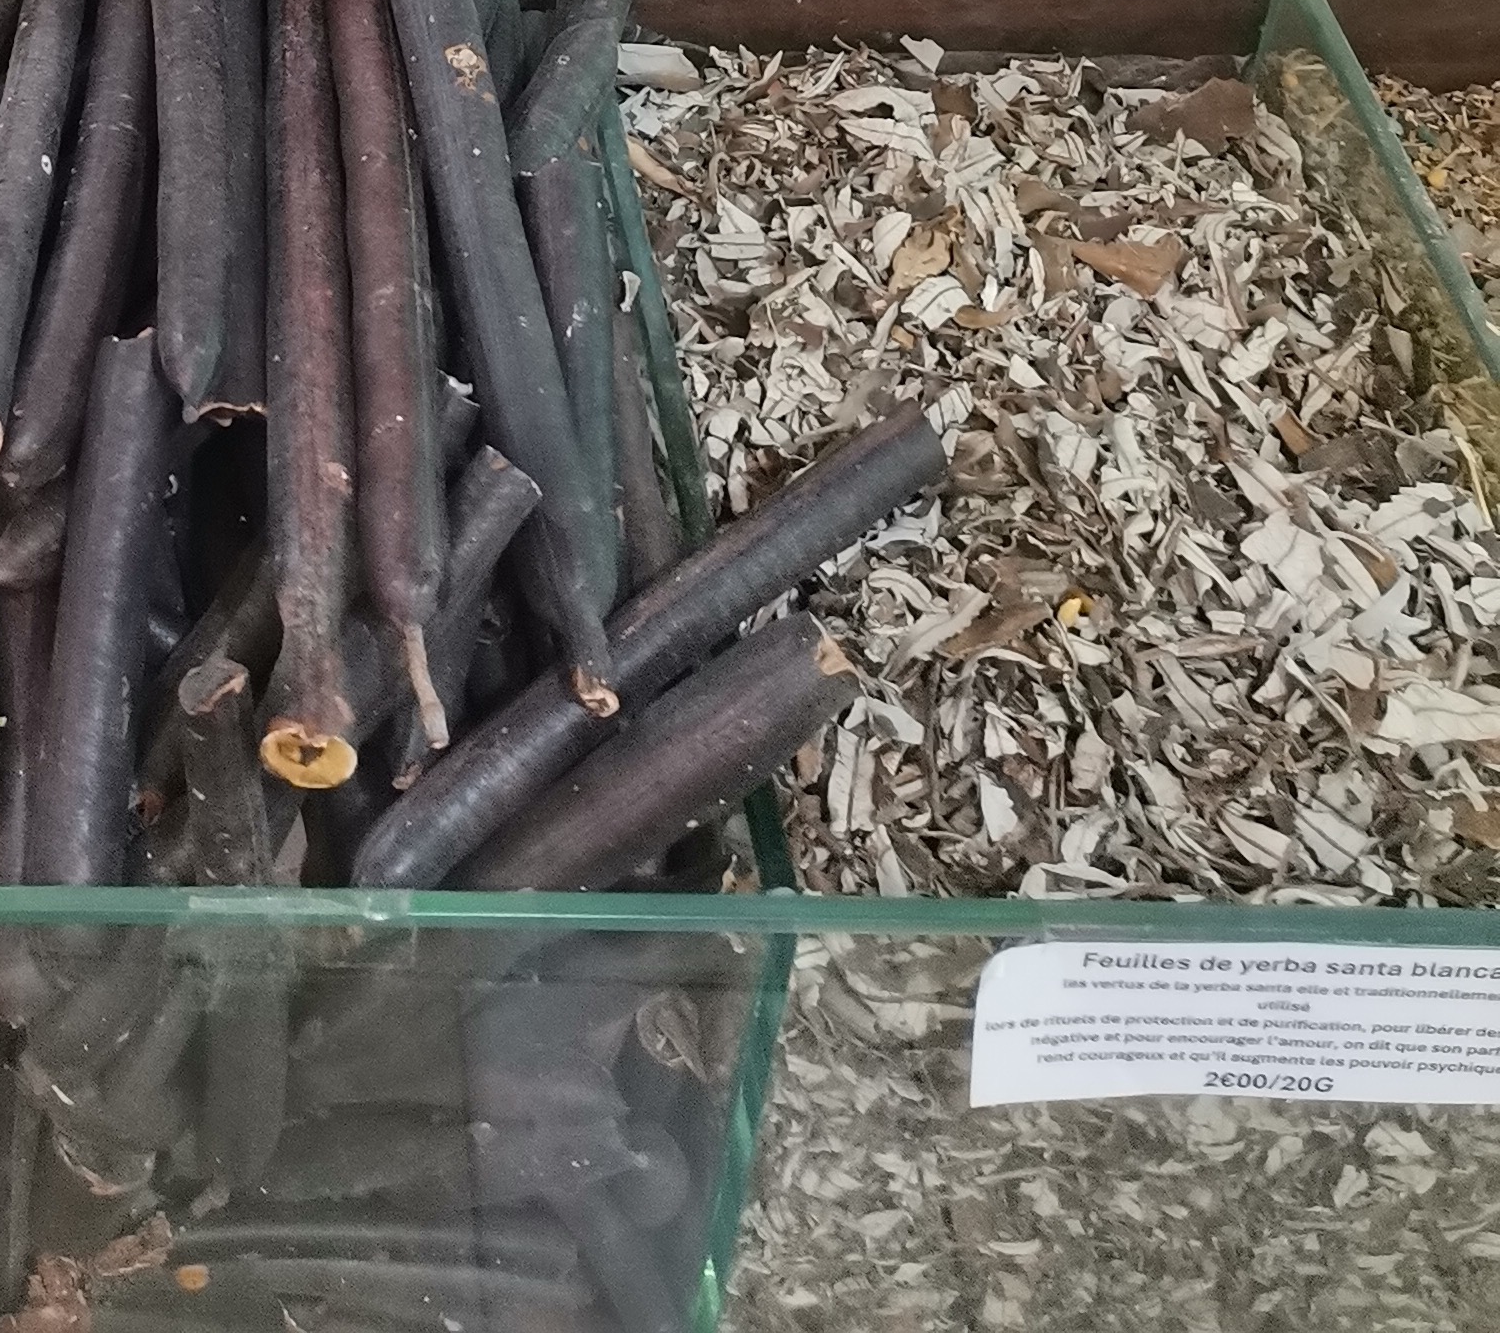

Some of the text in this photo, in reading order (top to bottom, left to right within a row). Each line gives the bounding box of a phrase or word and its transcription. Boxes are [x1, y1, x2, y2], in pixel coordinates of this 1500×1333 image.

[1083, 952, 1191, 971] Feuilles
[1199, 956, 1232, 972] de
[1240, 958, 1317, 975] yerba
[1325, 962, 1403, 977] santa
[1203, 1071, 1334, 1093] 2€00/20G
